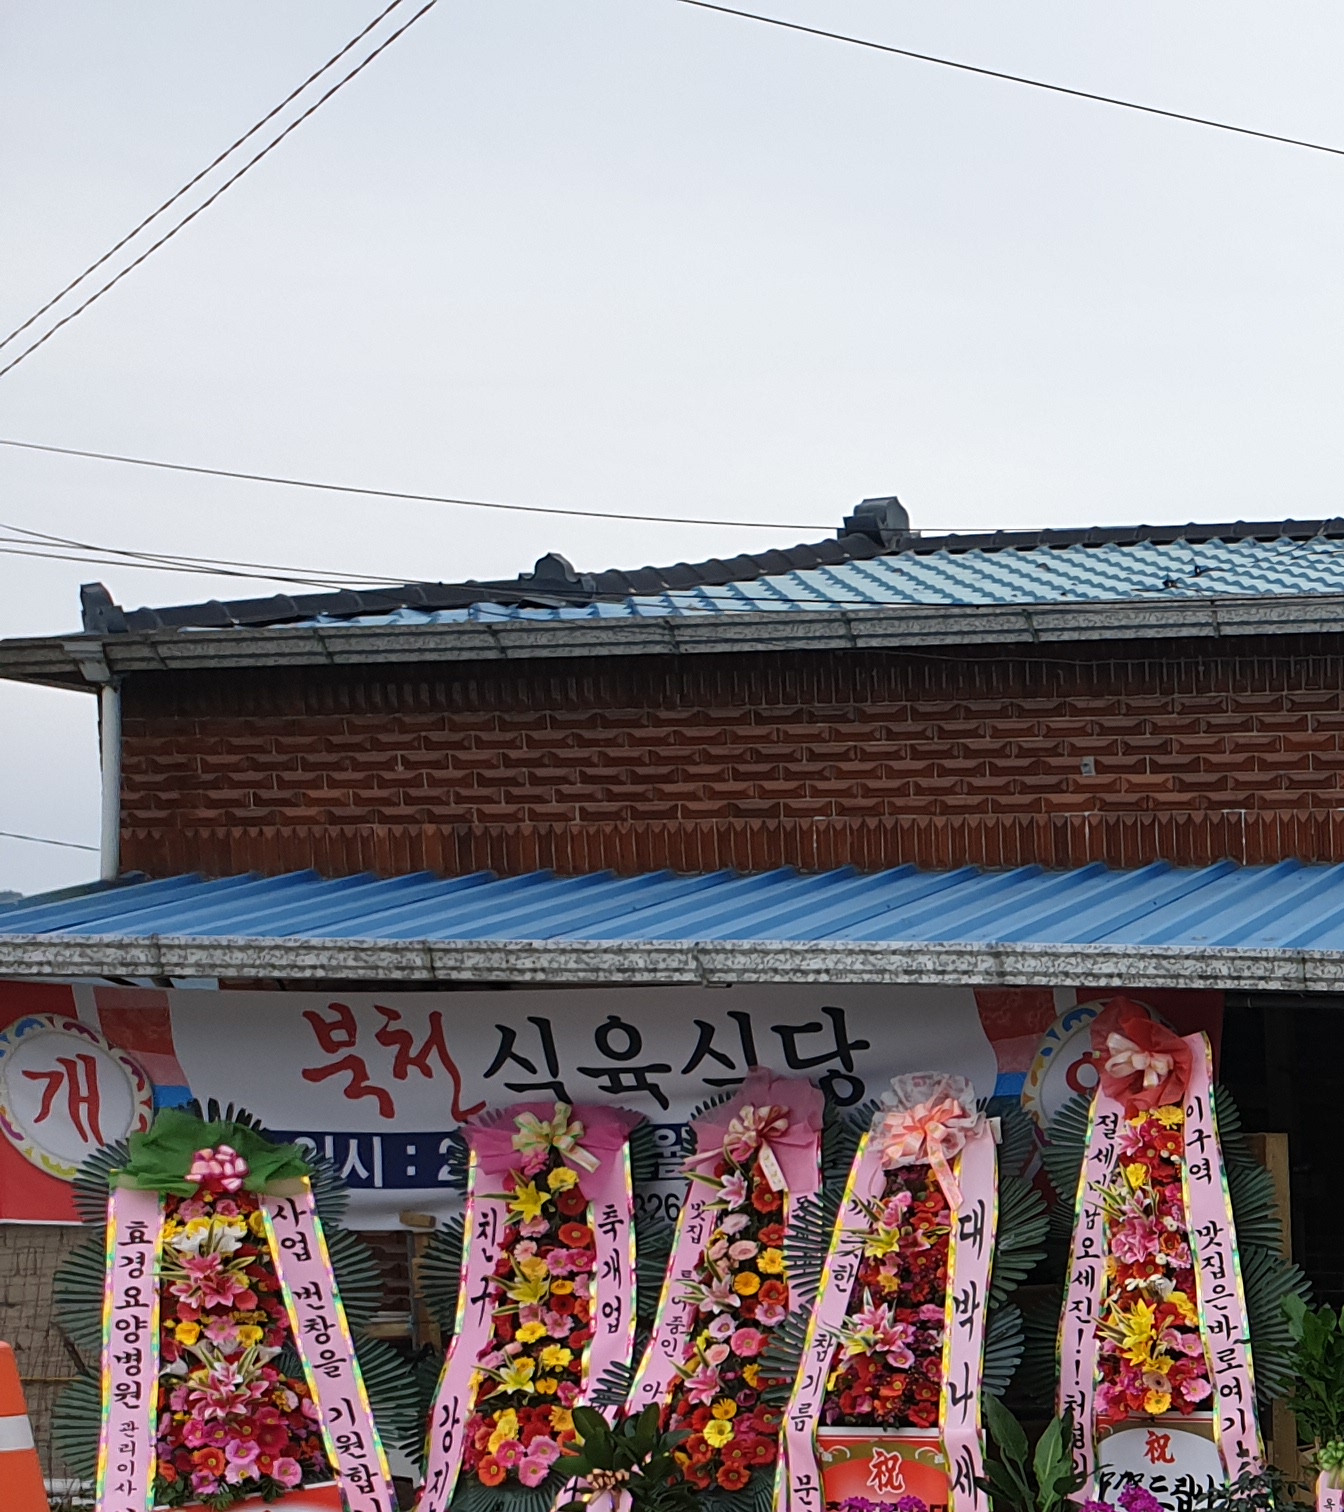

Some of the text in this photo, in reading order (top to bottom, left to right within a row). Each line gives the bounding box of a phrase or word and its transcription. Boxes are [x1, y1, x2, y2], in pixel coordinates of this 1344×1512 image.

[22, 1054, 103, 1144] 개
[302, 1002, 871, 1122] 북천 식육식당
[1185, 1096, 1213, 1185] 이구역
[470, 1206, 498, 1327] 친구
[686, 1199, 710, 1245] 맛집
[832, 1196, 874, 1293] 깨한
[113, 1221, 154, 1410] 효경요양병원
[272, 1198, 311, 1262] 사업
[292, 1281, 347, 1379] 번창을
[791, 1333, 835, 1432] 참기름
[114, 1420, 140, 1497] 관리이사
[867, 1448, 905, 1493] 祝
[1143, 1429, 1176, 1465] 祝
